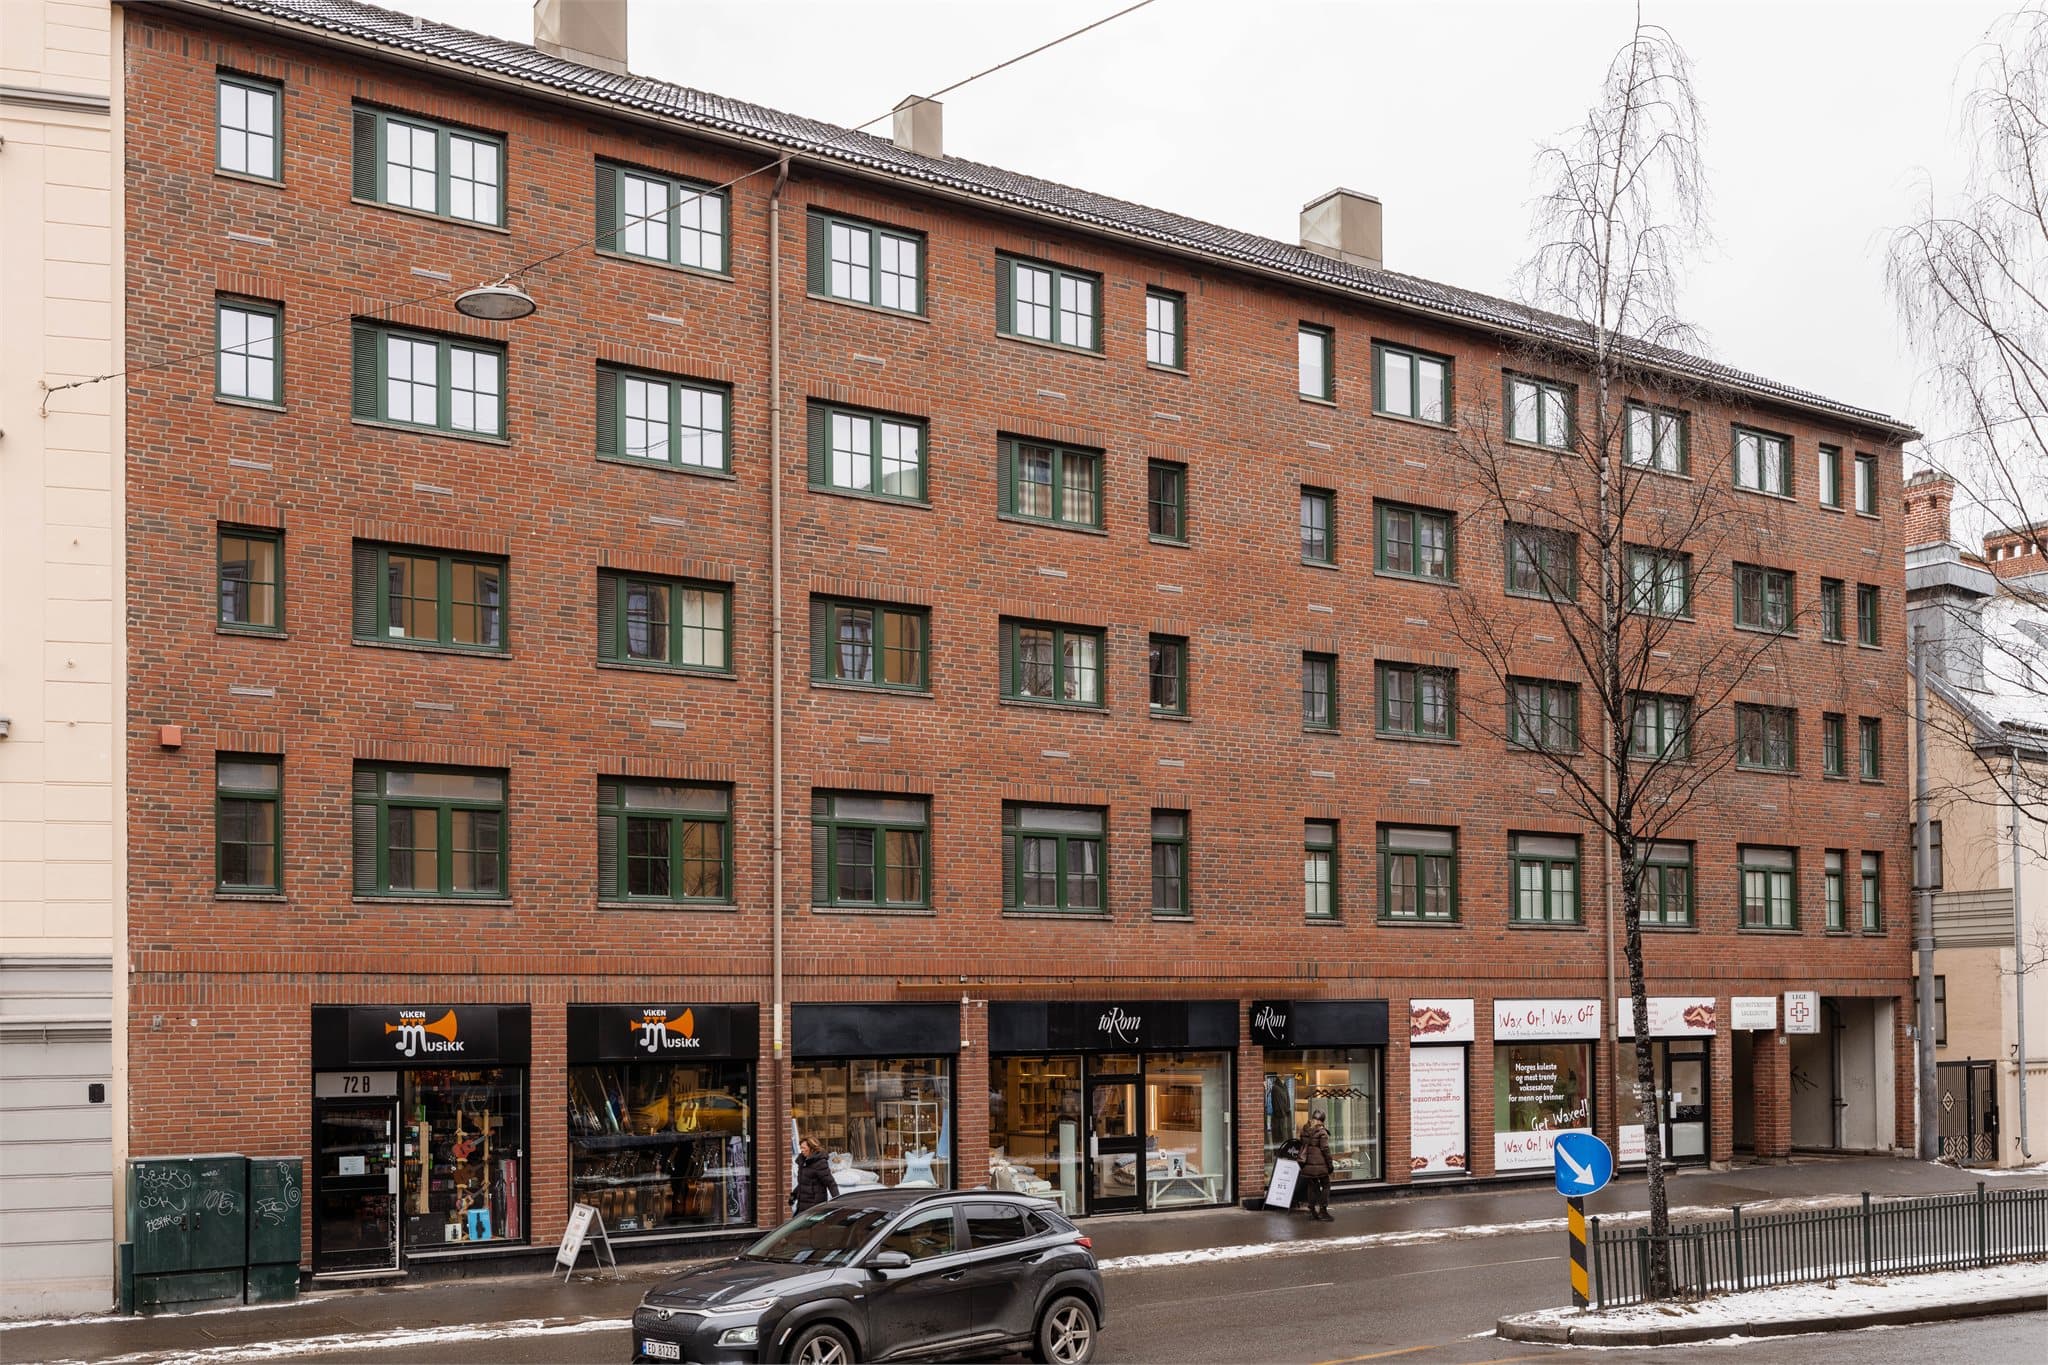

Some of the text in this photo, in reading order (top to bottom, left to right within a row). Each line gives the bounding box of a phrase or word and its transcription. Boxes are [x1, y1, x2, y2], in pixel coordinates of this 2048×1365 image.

[1499, 1011, 1522, 1028] Wax
[1551, 1008, 1572, 1025] Wax
[1577, 1005, 1594, 1026] Off
[1515, 1062, 1557, 1073] Norges kuleste
[343, 1076, 370, 1093] 72 B
[1515, 1075, 1523, 1084] og
[1538, 1072, 1557, 1082] trendy
[1519, 1083, 1554, 1093] voksesalong
[1508, 1094, 1517, 1102] for
[1535, 1094, 1543, 1103] og
[1543, 1093, 1564, 1101] kvinner
[1531, 1098, 1589, 1131] Get Waxed!
[1504, 1138, 1523, 1153] Wax
